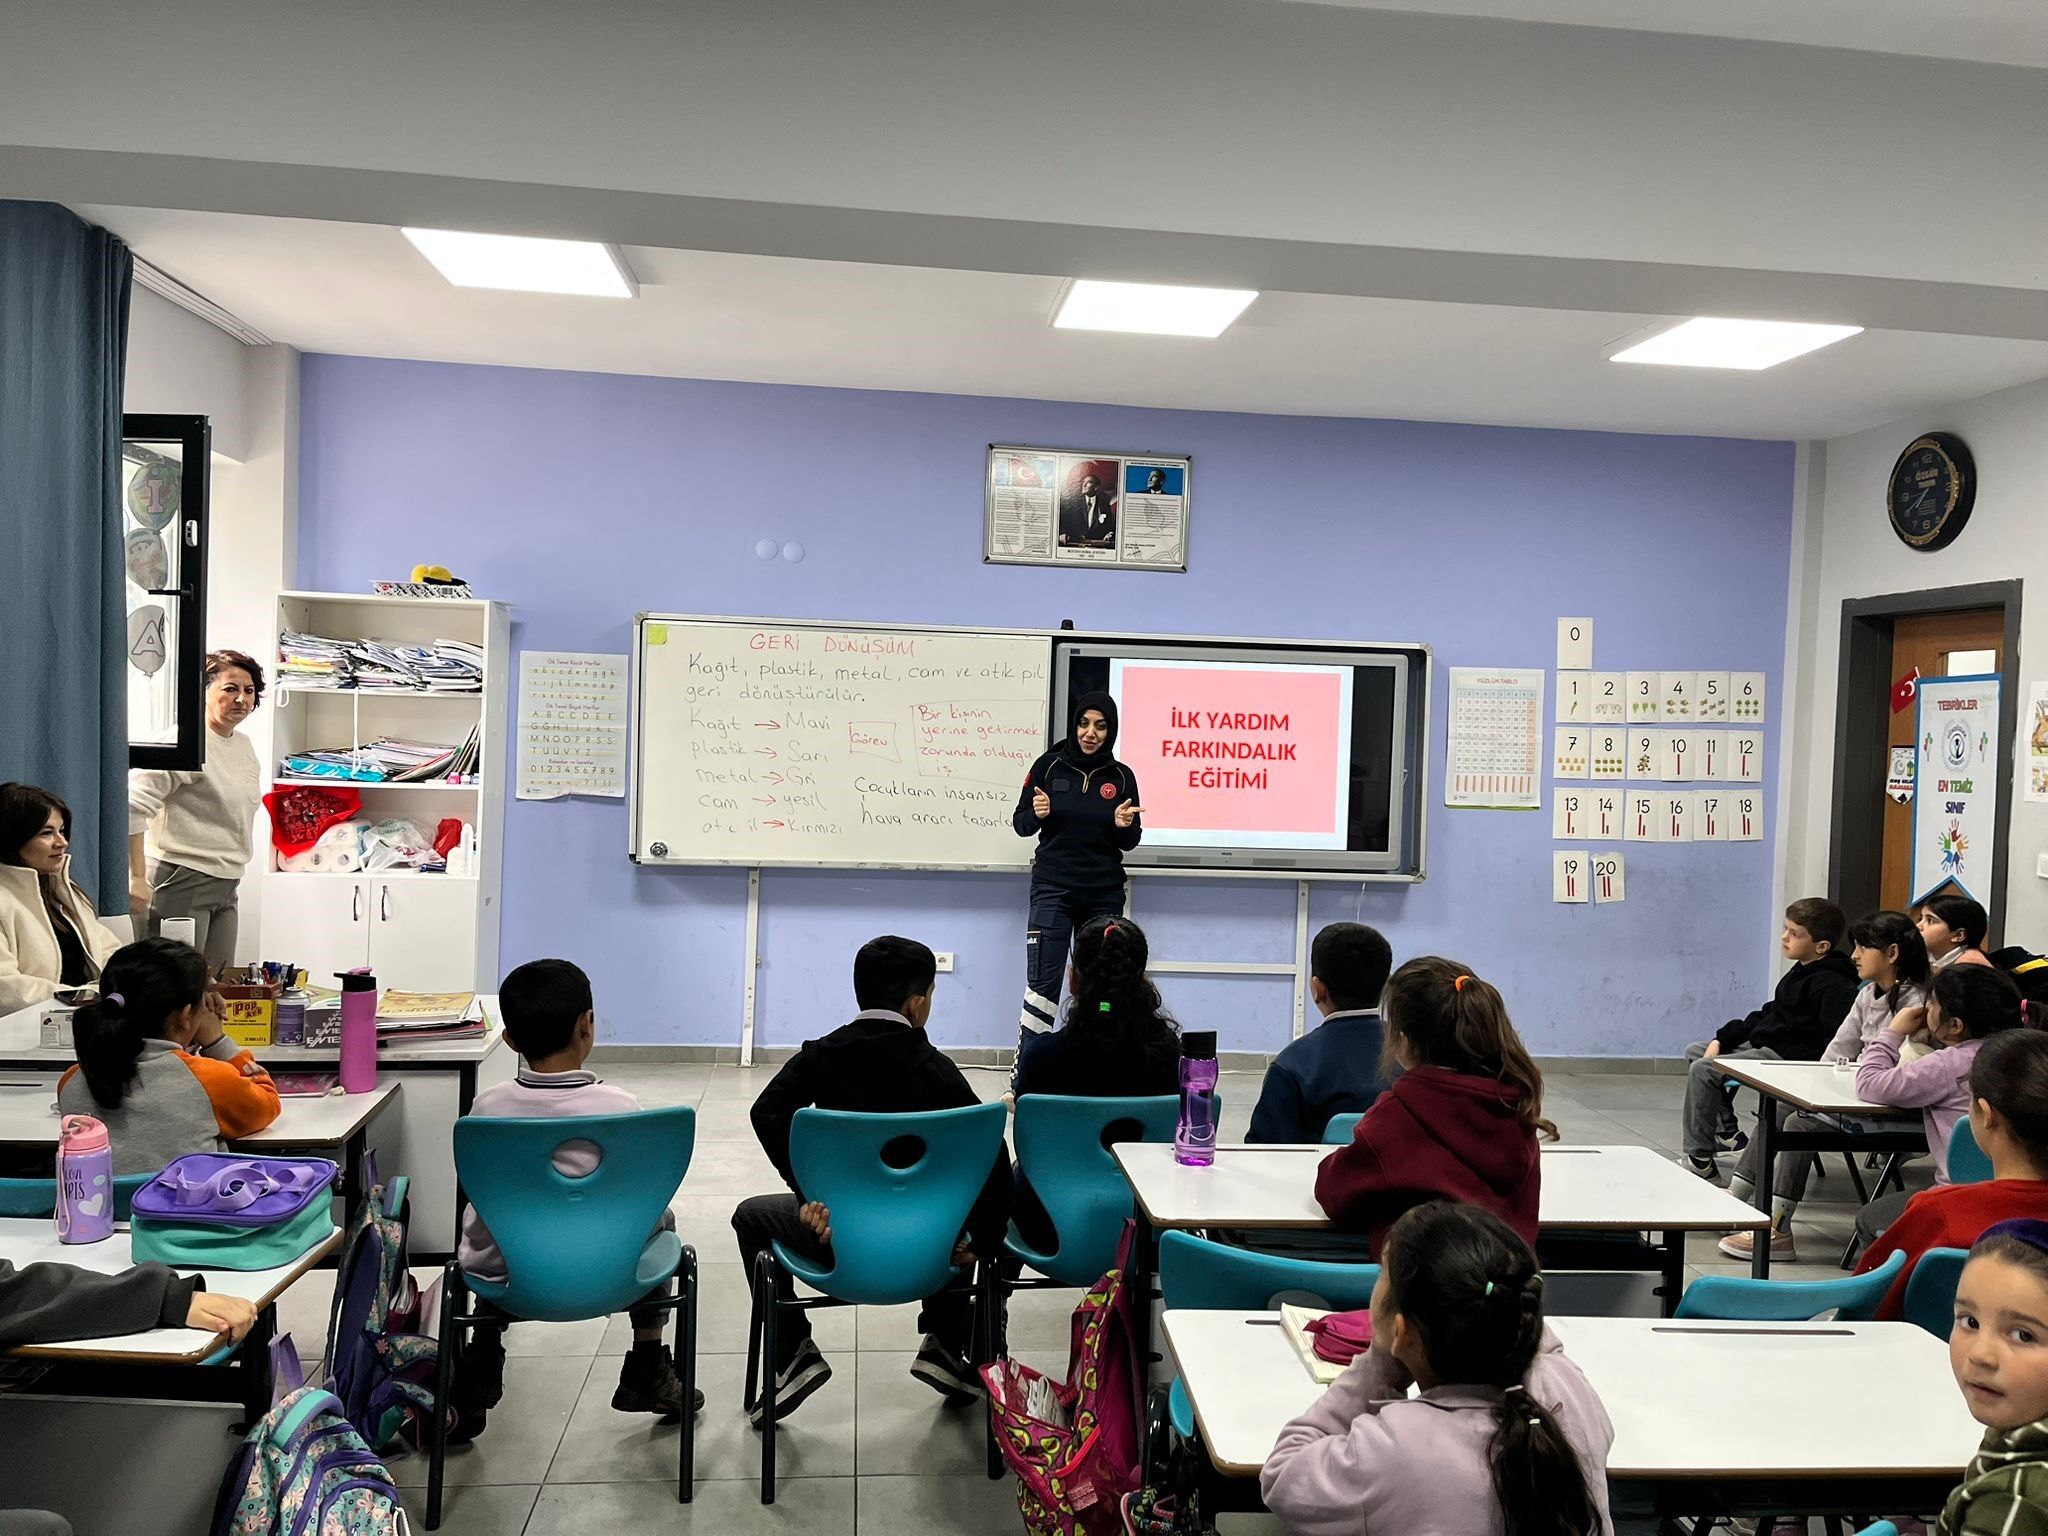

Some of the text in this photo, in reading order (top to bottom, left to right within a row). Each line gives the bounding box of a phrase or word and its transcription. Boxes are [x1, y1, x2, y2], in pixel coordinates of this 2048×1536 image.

[1570, 627, 1580, 640] 0
[750, 633, 914, 659] GERİ DÖNÜŞÜM
[908, 668, 944, 680] cam
[956, 668, 968, 677] ve
[1022, 664, 1045, 684] pil
[685, 686, 720, 703] geri
[1573, 681, 1752, 695] 1 2 3 4 5 6
[1938, 698, 1977, 710] TEBRİKLER
[787, 712, 830, 730] Mavi
[918, 705, 940, 721] Bir
[1171, 707, 1289, 731] İLK YARDIM
[922, 724, 1041, 743] yerine getirmek
[788, 740, 828, 762] Sarı
[920, 747, 976, 758] zorunda
[1162, 740, 1296, 760] FARKINDALIK
[1569, 737, 1753, 754] 7 8 9 10 11 12
[787, 766, 815, 785] Gri
[1189, 767, 1267, 789] EĞİTİMİ
[945, 787, 1011, 801] insansız
[1938, 778, 1973, 793] EN TEMİZ
[861, 802, 902, 824] hava
[912, 813, 952, 824] aracı
[1566, 798, 1752, 814] 13 14 15 16 17 18
[1945, 802, 1965, 814] SINIF
[1564, 860, 1616, 876] 19 20
